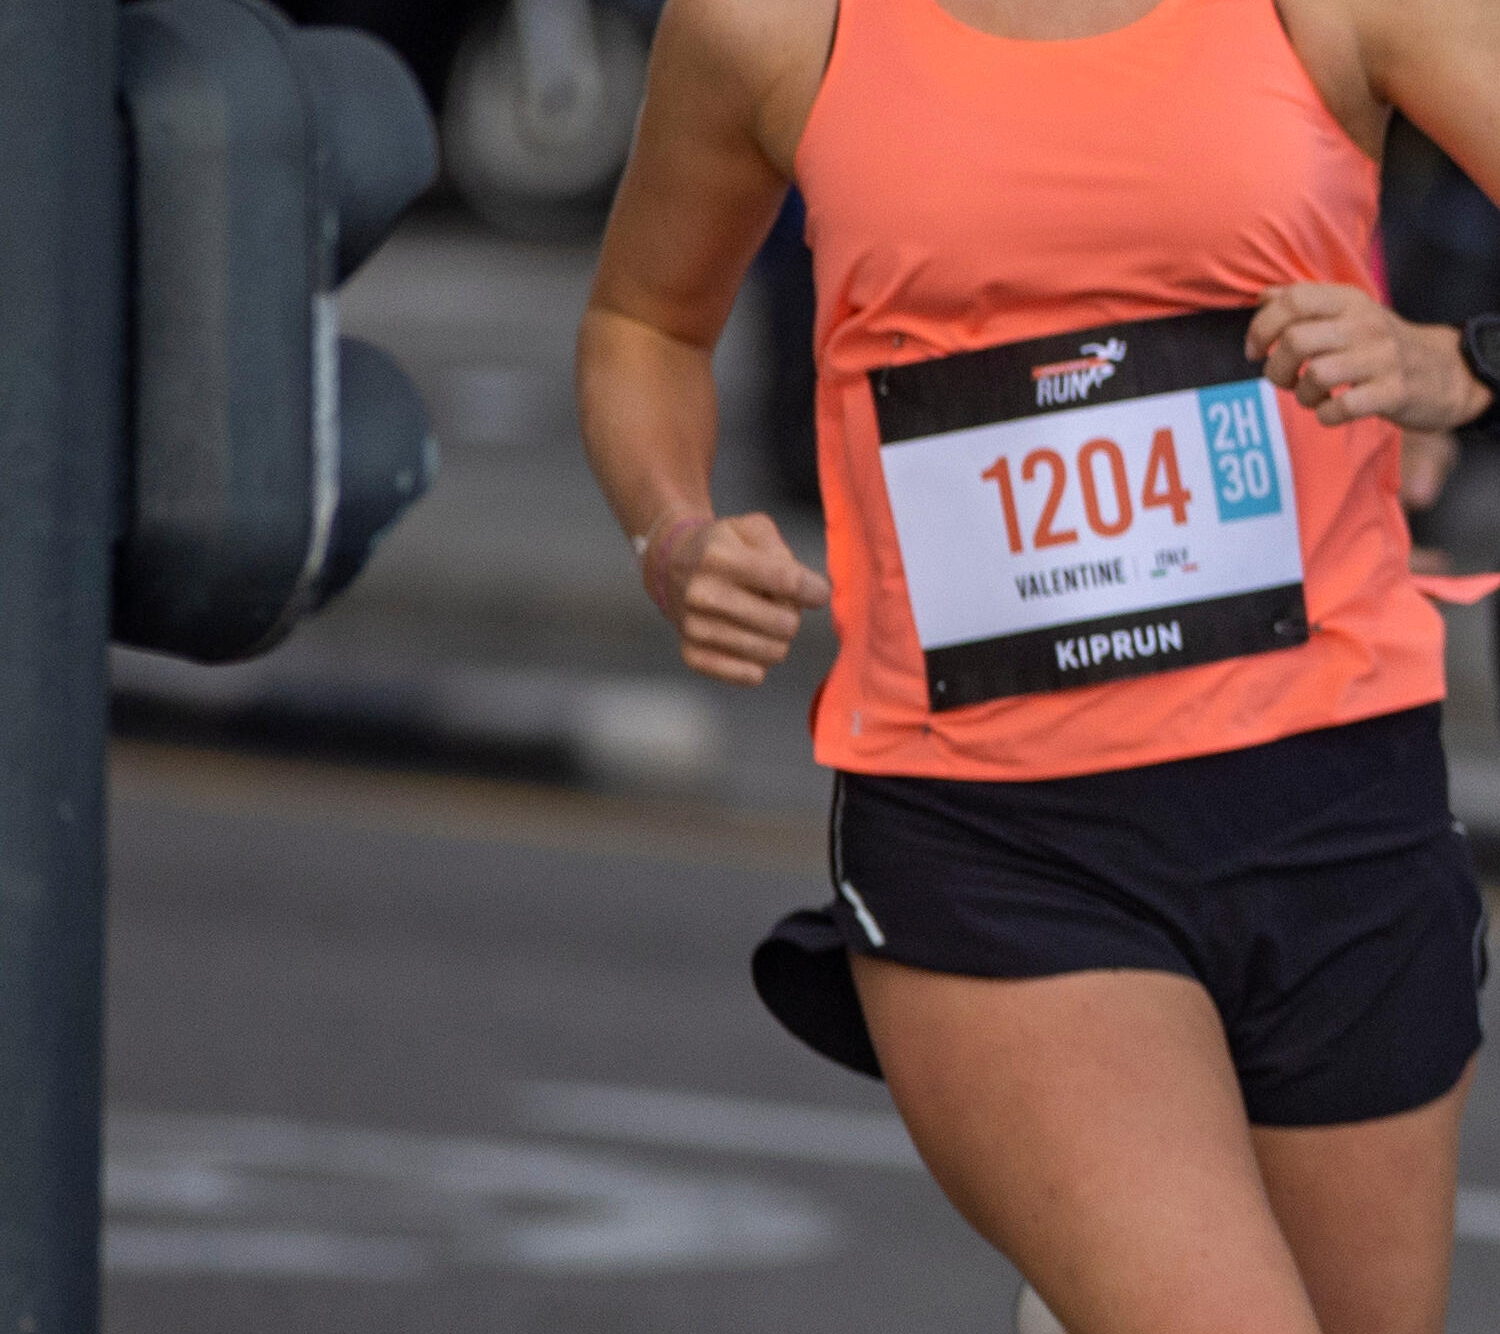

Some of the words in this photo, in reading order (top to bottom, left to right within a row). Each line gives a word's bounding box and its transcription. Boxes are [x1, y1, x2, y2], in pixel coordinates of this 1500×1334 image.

[1036, 370, 1089, 408] RUN
[1208, 398, 1262, 451] 2H
[981, 427, 1191, 555] 1204
[1222, 450, 1271, 502] 30
[1015, 558, 1127, 602] VALENTINE
[1055, 620, 1184, 671] KIPRUN
